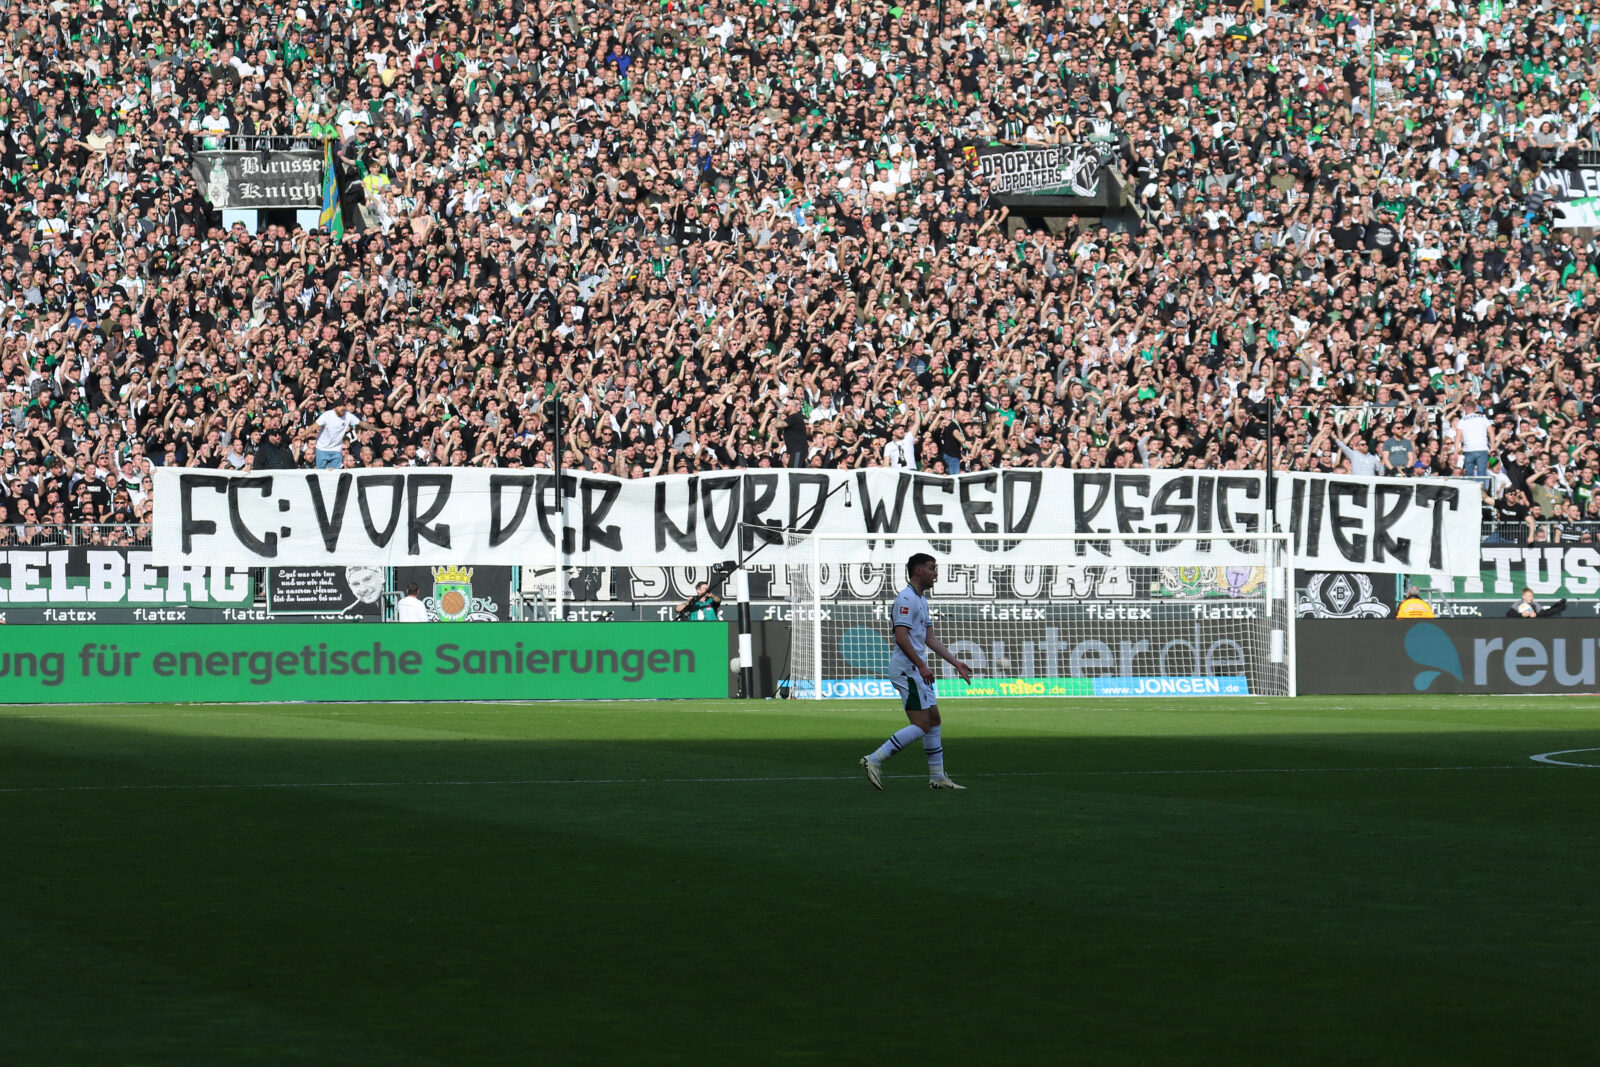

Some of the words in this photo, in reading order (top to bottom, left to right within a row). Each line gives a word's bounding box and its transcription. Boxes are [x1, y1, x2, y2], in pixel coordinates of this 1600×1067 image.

[180, 474, 291, 558] FC:
[305, 472, 452, 556] VOR
[489, 474, 623, 555] DER
[655, 472, 830, 553] NORD
[856, 471, 1042, 555] WEED
[0, 550, 249, 602] ELBERG
[43, 608, 97, 621] flatex
[133, 608, 186, 621] flatex
[980, 606, 1046, 620] flatex
[1086, 605, 1152, 620] flatex
[1191, 604, 1257, 619] flatex
[78, 643, 141, 677] für
[152, 641, 423, 685] energetische
[435, 641, 696, 683] Sanierungen
[1474, 637, 1600, 687] reu
[822, 681, 901, 697] JONGE
[1134, 678, 1220, 694] JONGEN
